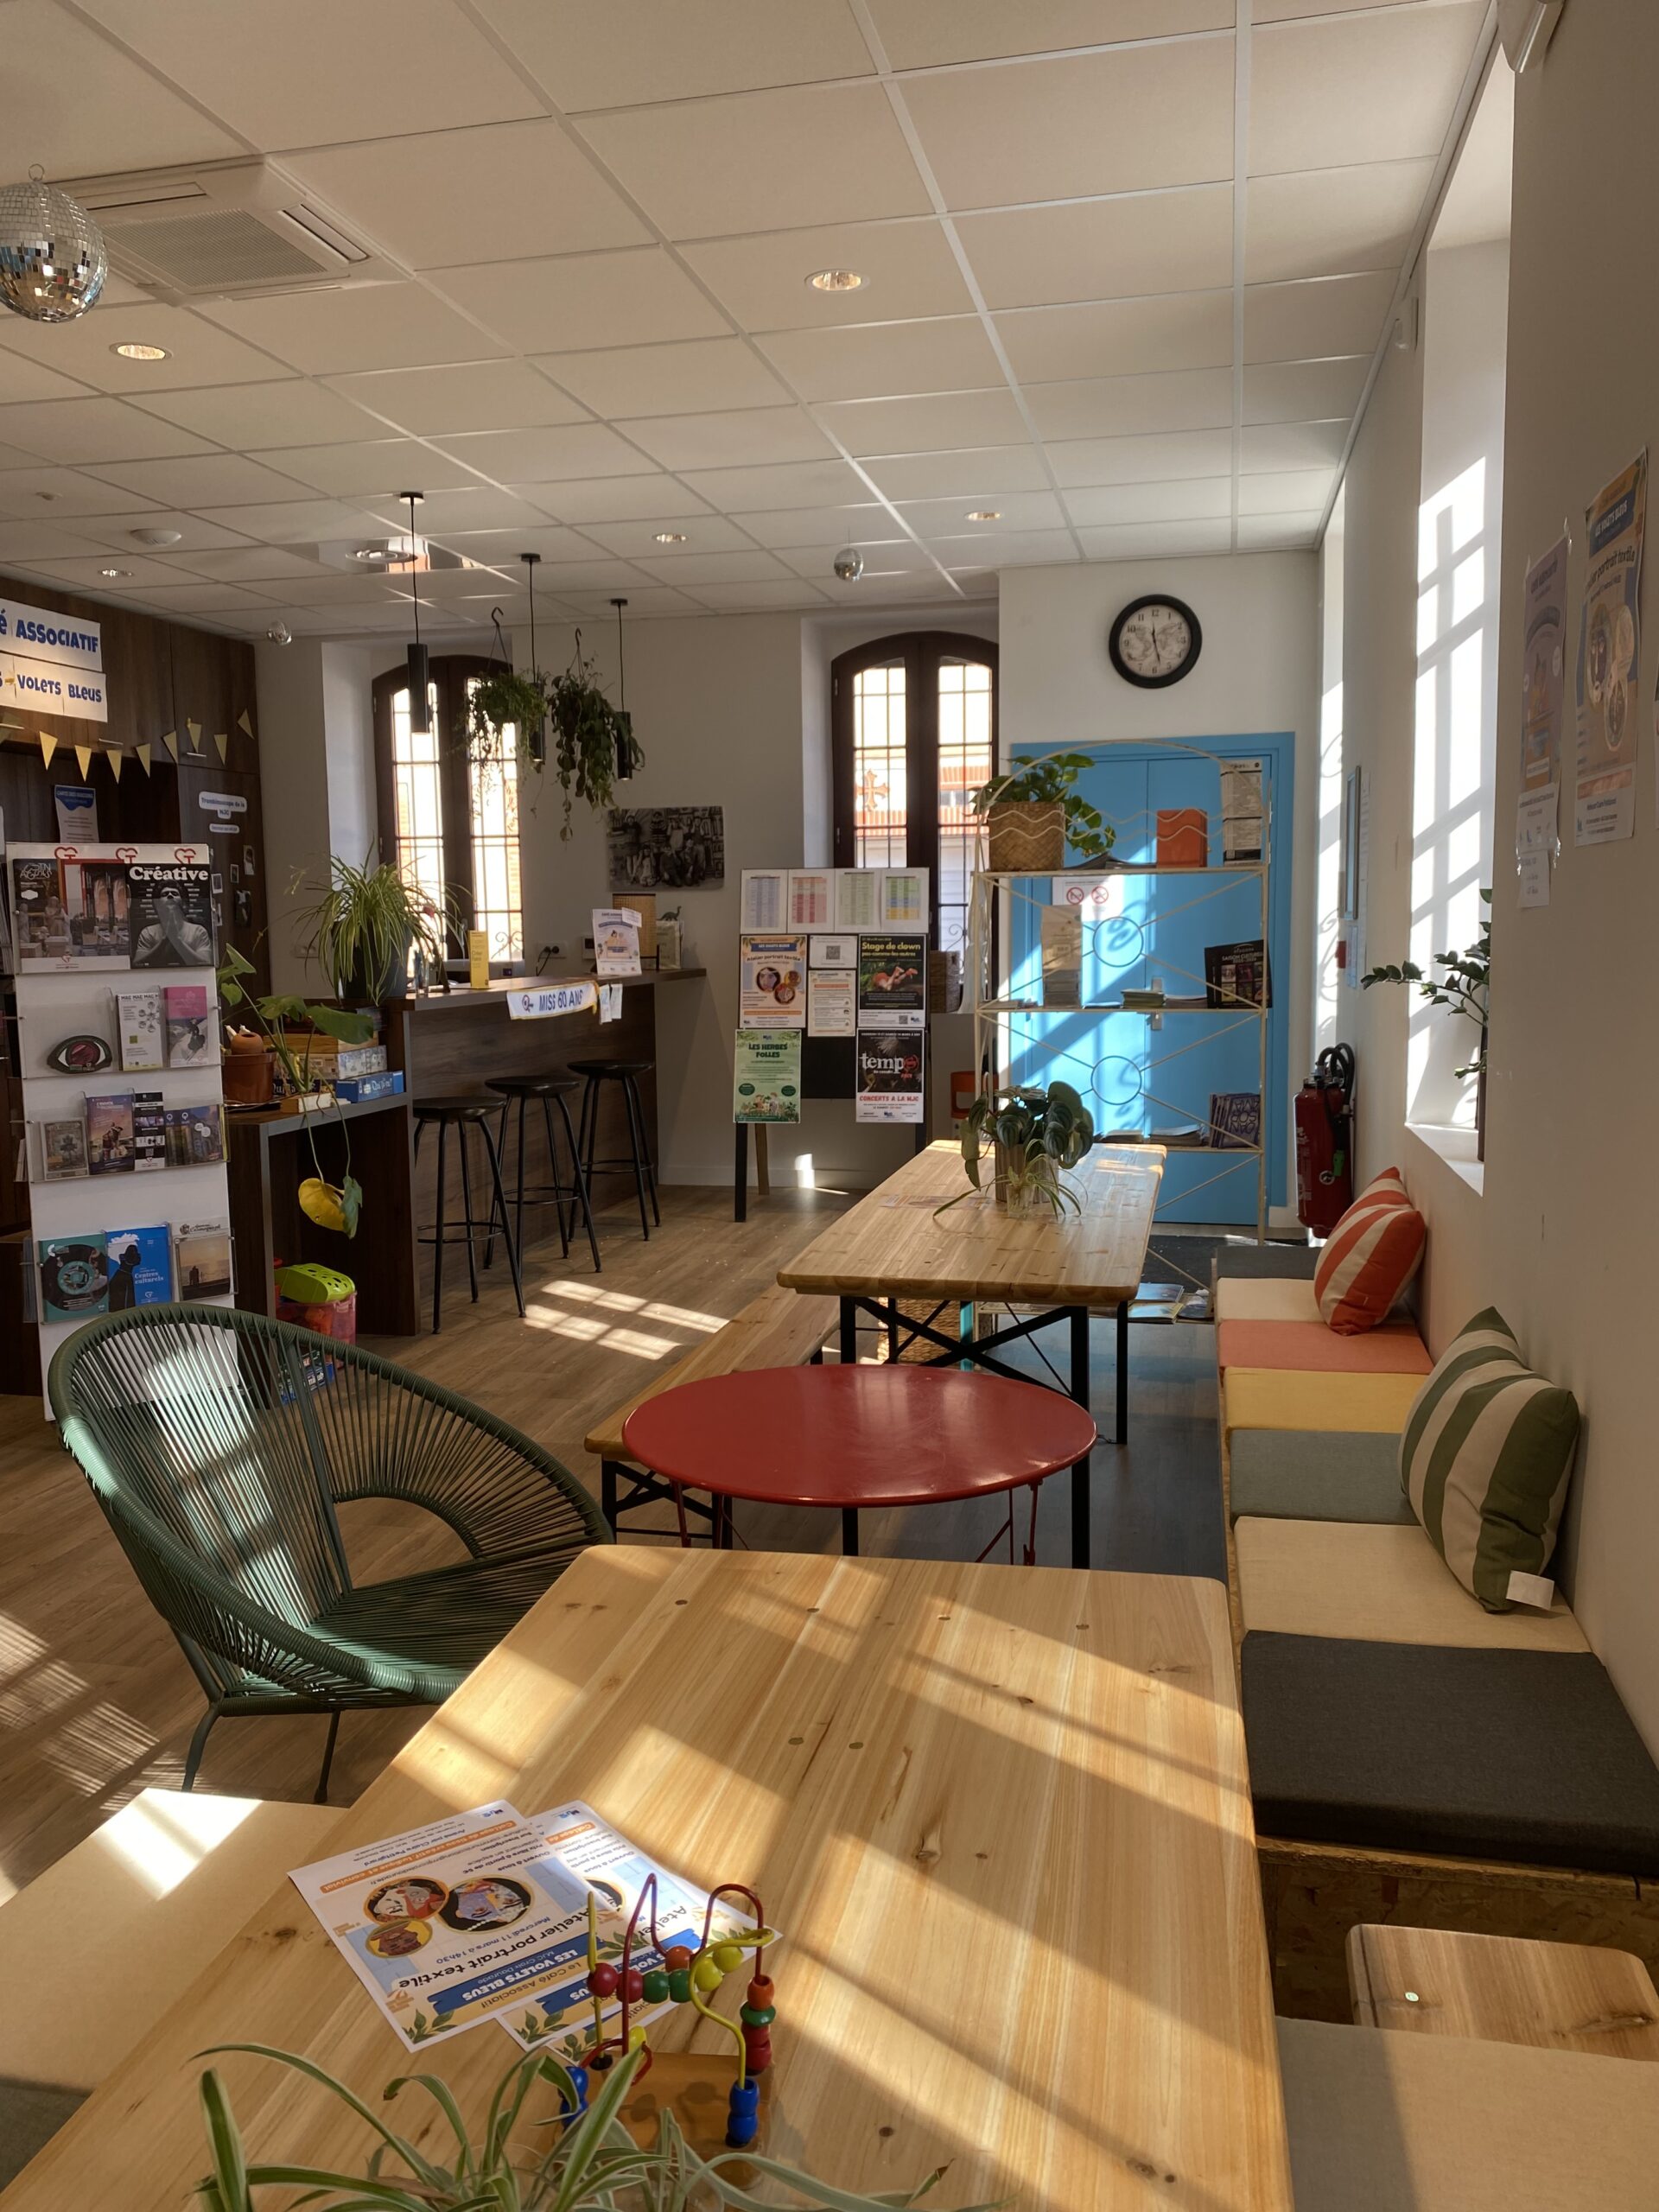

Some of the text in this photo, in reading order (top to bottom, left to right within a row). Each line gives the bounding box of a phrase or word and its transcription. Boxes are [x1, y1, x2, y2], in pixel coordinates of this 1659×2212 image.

[16, 620, 99, 652] ASSOCIATIF
[129, 866, 208, 880] Créative
[861, 941, 885, 950] Stage
[897, 942, 921, 950] clown
[539, 993, 556, 1012] MISS
[557, 991, 568, 1008] 60
[135, 1276, 164, 1285] culturels
[480, 1835, 519, 1852] inscription
[512, 1847, 529, 1857] libre
[523, 1850, 550, 1863] Ouvert
[607, 1850, 633, 1864] Ouvert
[485, 1855, 505, 1866] partir
[497, 1862, 516, 1872] tous
[583, 1863, 601, 1873] tous
[323, 1872, 365, 1891] convivial
[512, 1915, 550, 1937] Mercredi
[475, 1937, 499, 1949] mars
[500, 1933, 512, 1942] 11
[397, 1907, 591, 1991] Atelier portrait textile
[435, 1948, 467, 1964] 14h30
[476, 1949, 554, 1985] MJC Croix Daurade
[461, 1948, 578, 2001] LES VOLETS BLEUS
[480, 1961, 582, 2009] Le Café Associatif
